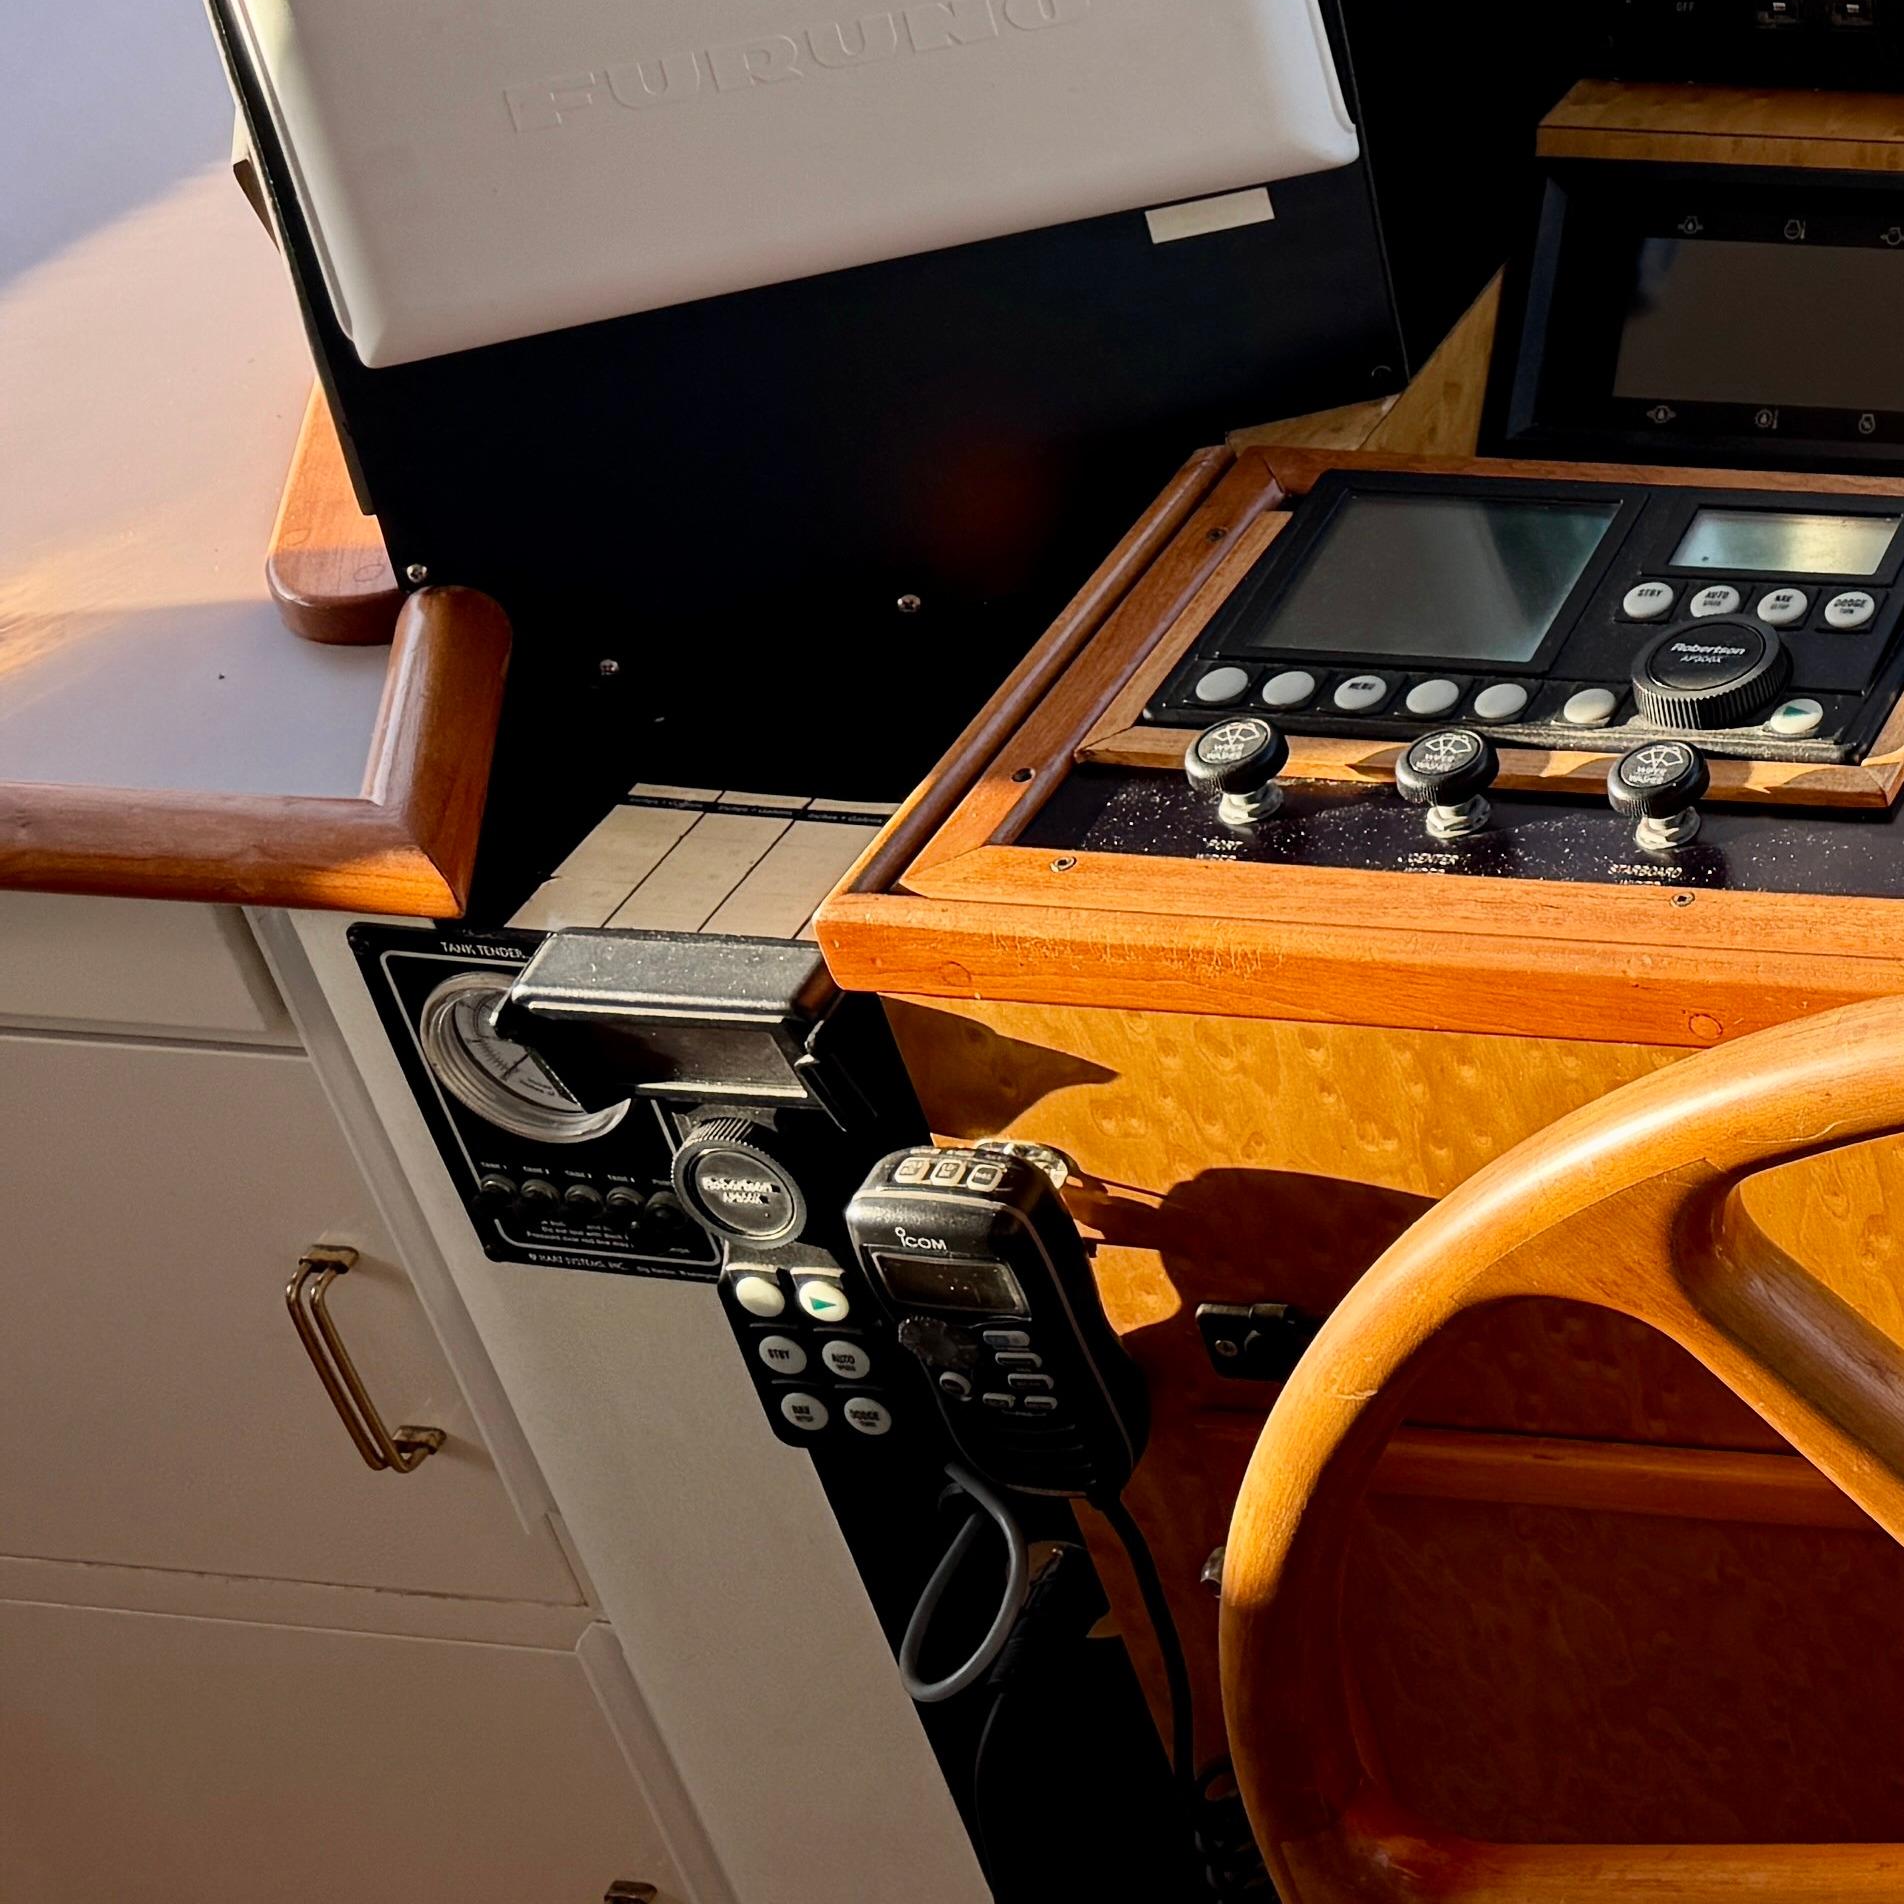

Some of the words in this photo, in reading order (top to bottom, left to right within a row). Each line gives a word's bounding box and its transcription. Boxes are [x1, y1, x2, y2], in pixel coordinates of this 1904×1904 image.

[1670, 642, 1747, 656] Robertson
[1607, 863, 1683, 878] STARBOARD
[440, 940, 476, 956] TANK
[475, 944, 526, 959] TENDER
[702, 1176, 773, 1193] Robertson
